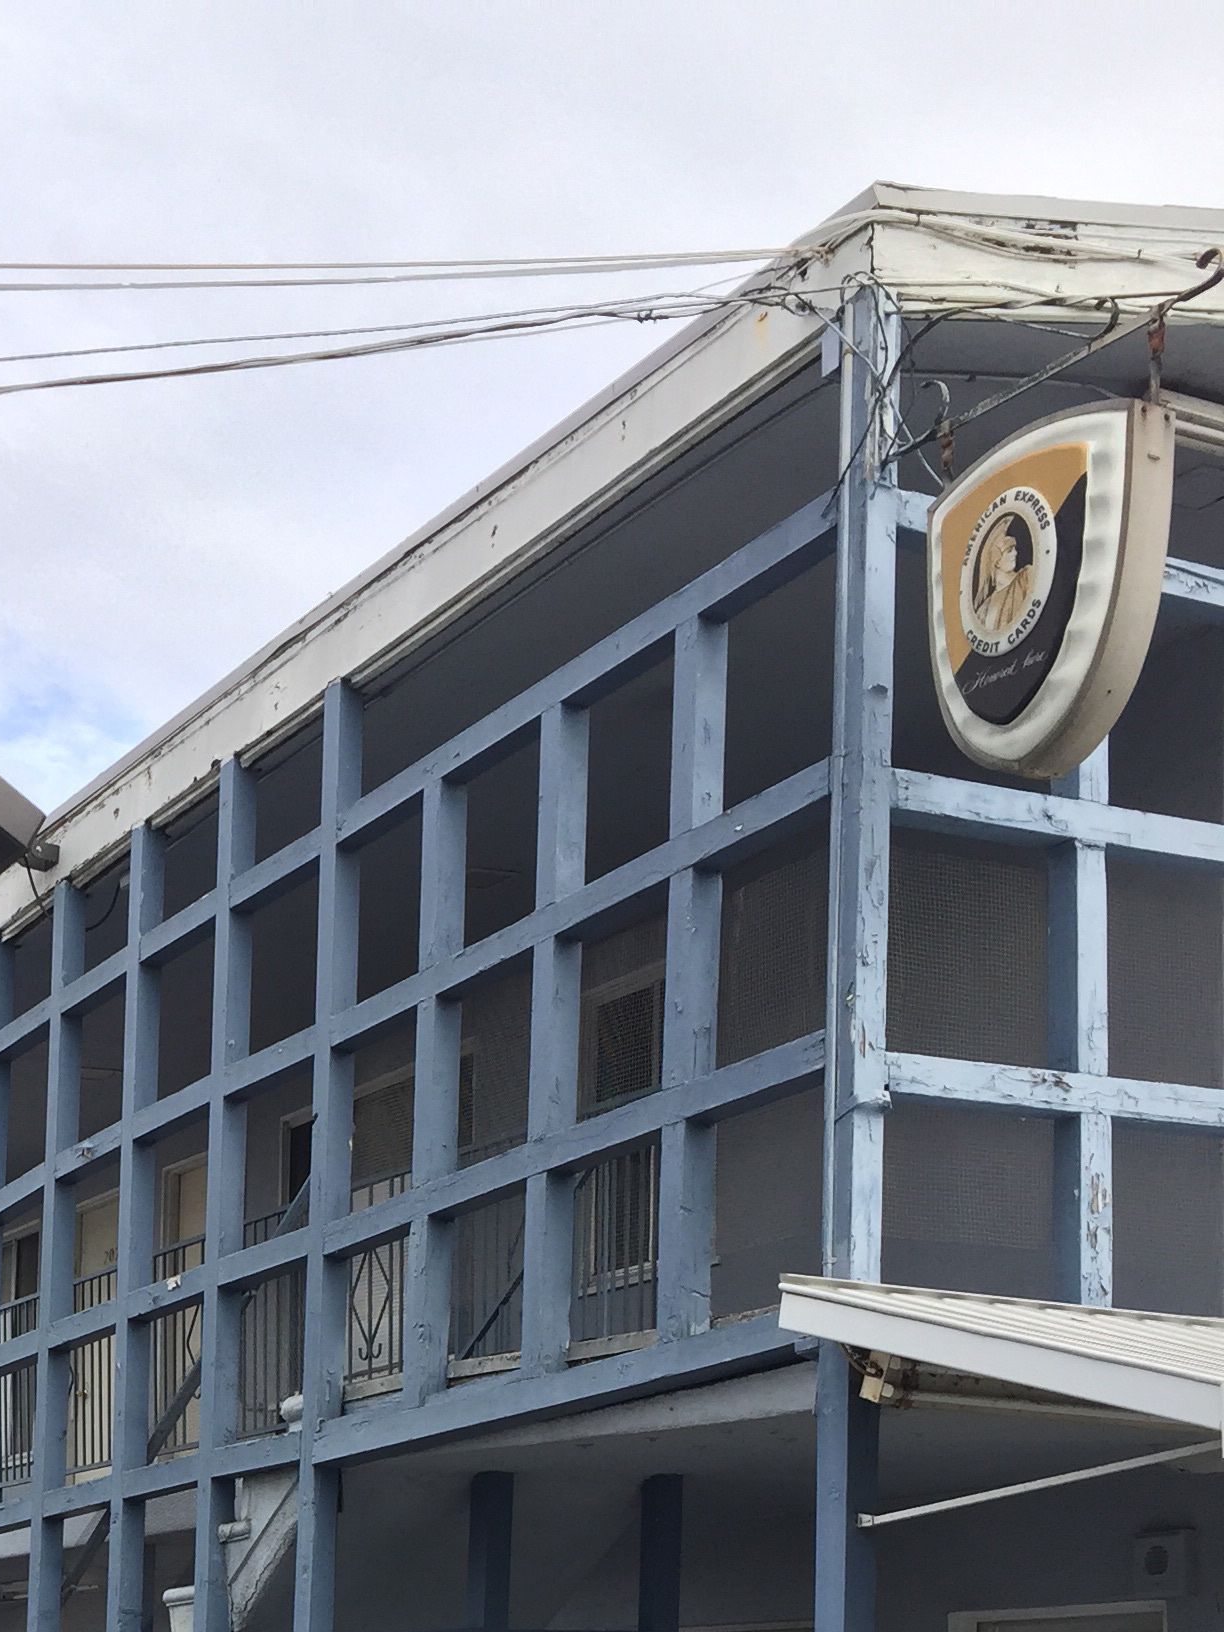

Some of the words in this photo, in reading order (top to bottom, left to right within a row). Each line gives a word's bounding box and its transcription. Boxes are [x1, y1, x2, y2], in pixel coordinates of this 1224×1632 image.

[962, 495, 1007, 566] AMERICAN
[1014, 490, 1051, 531] EXPRESS
[965, 629, 1000, 653] CREDIT
[1007, 598, 1042, 646] CARDS
